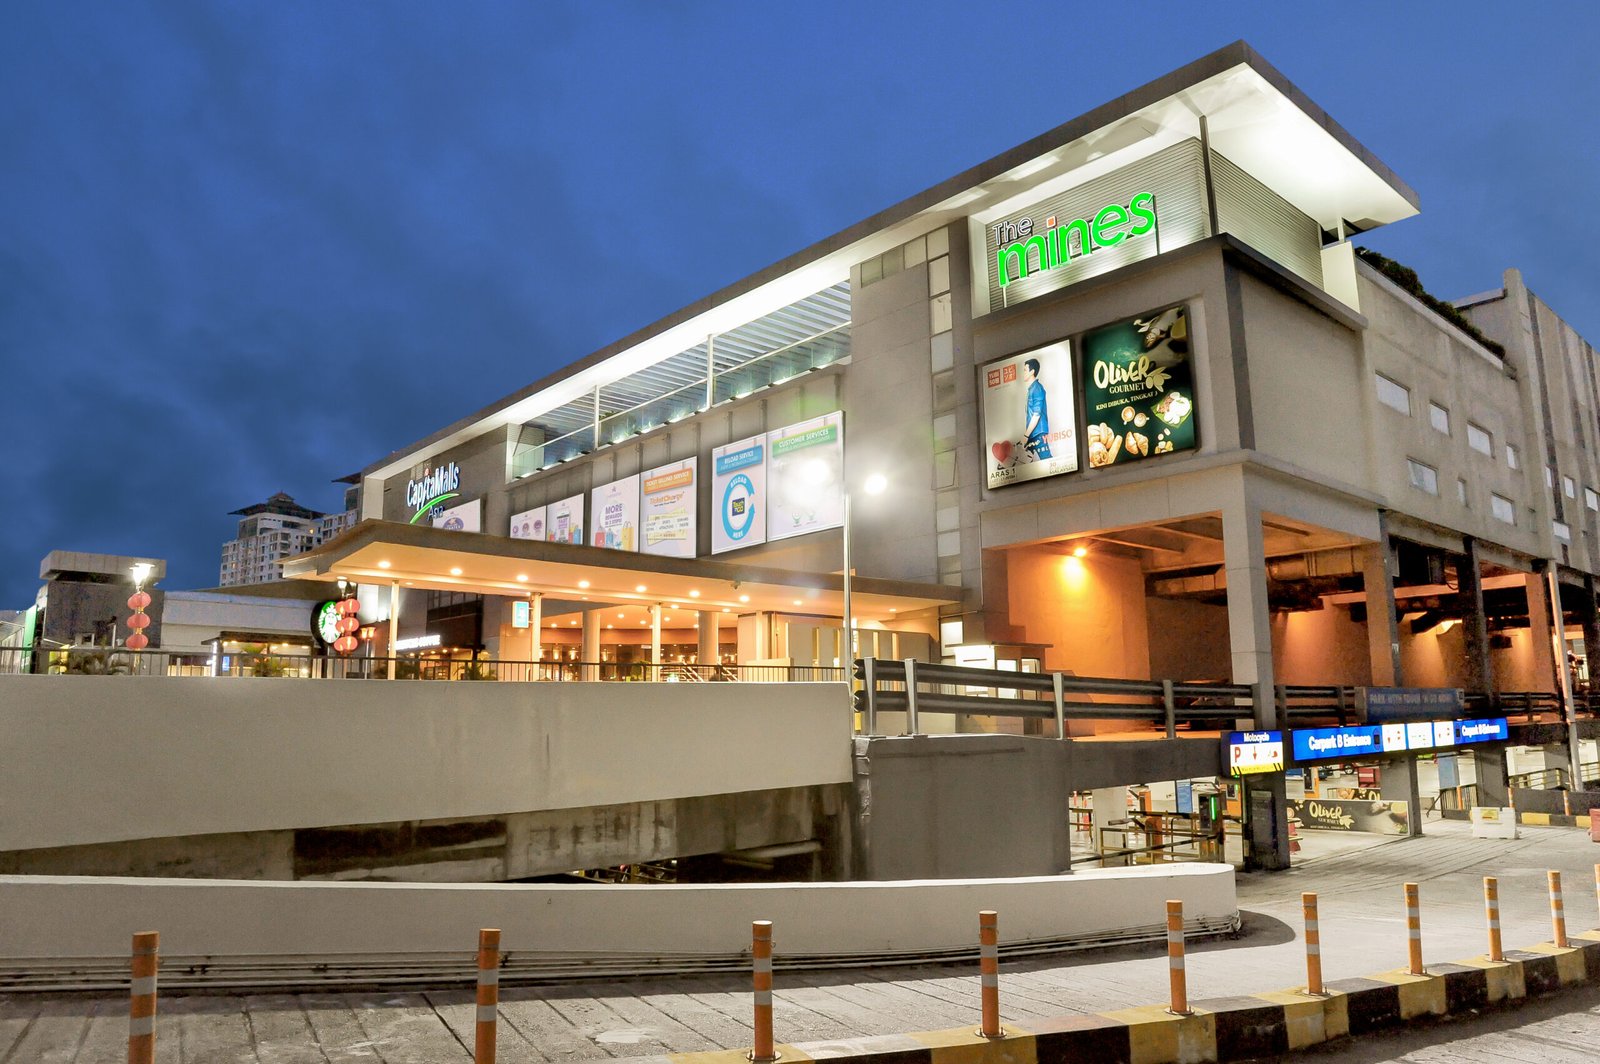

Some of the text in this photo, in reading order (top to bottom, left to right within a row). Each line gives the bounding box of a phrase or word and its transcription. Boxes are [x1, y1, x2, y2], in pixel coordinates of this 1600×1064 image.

[992, 217, 1033, 246] The
[997, 192, 1157, 288] mines
[1109, 382, 1146, 394] GOURMET
[1096, 402, 1108, 411] KINI
[1130, 391, 1154, 402] TINGKAT
[778, 436, 805, 448] CUSTOMER
[806, 428, 829, 441] SERVICES
[1042, 429, 1073, 444] YUBISO
[724, 454, 739, 464] RELOAD
[739, 450, 754, 460] SERVICE
[730, 476, 747, 488] RELOAD
[991, 470, 1010, 480] ARAS
[407, 461, 460, 511] CapitaMalls
[605, 503, 623, 514] MORE
[732, 531, 744, 539] HERE
[1308, 733, 1371, 752] Carpark B Entrance
[1234, 746, 1241, 763] P
